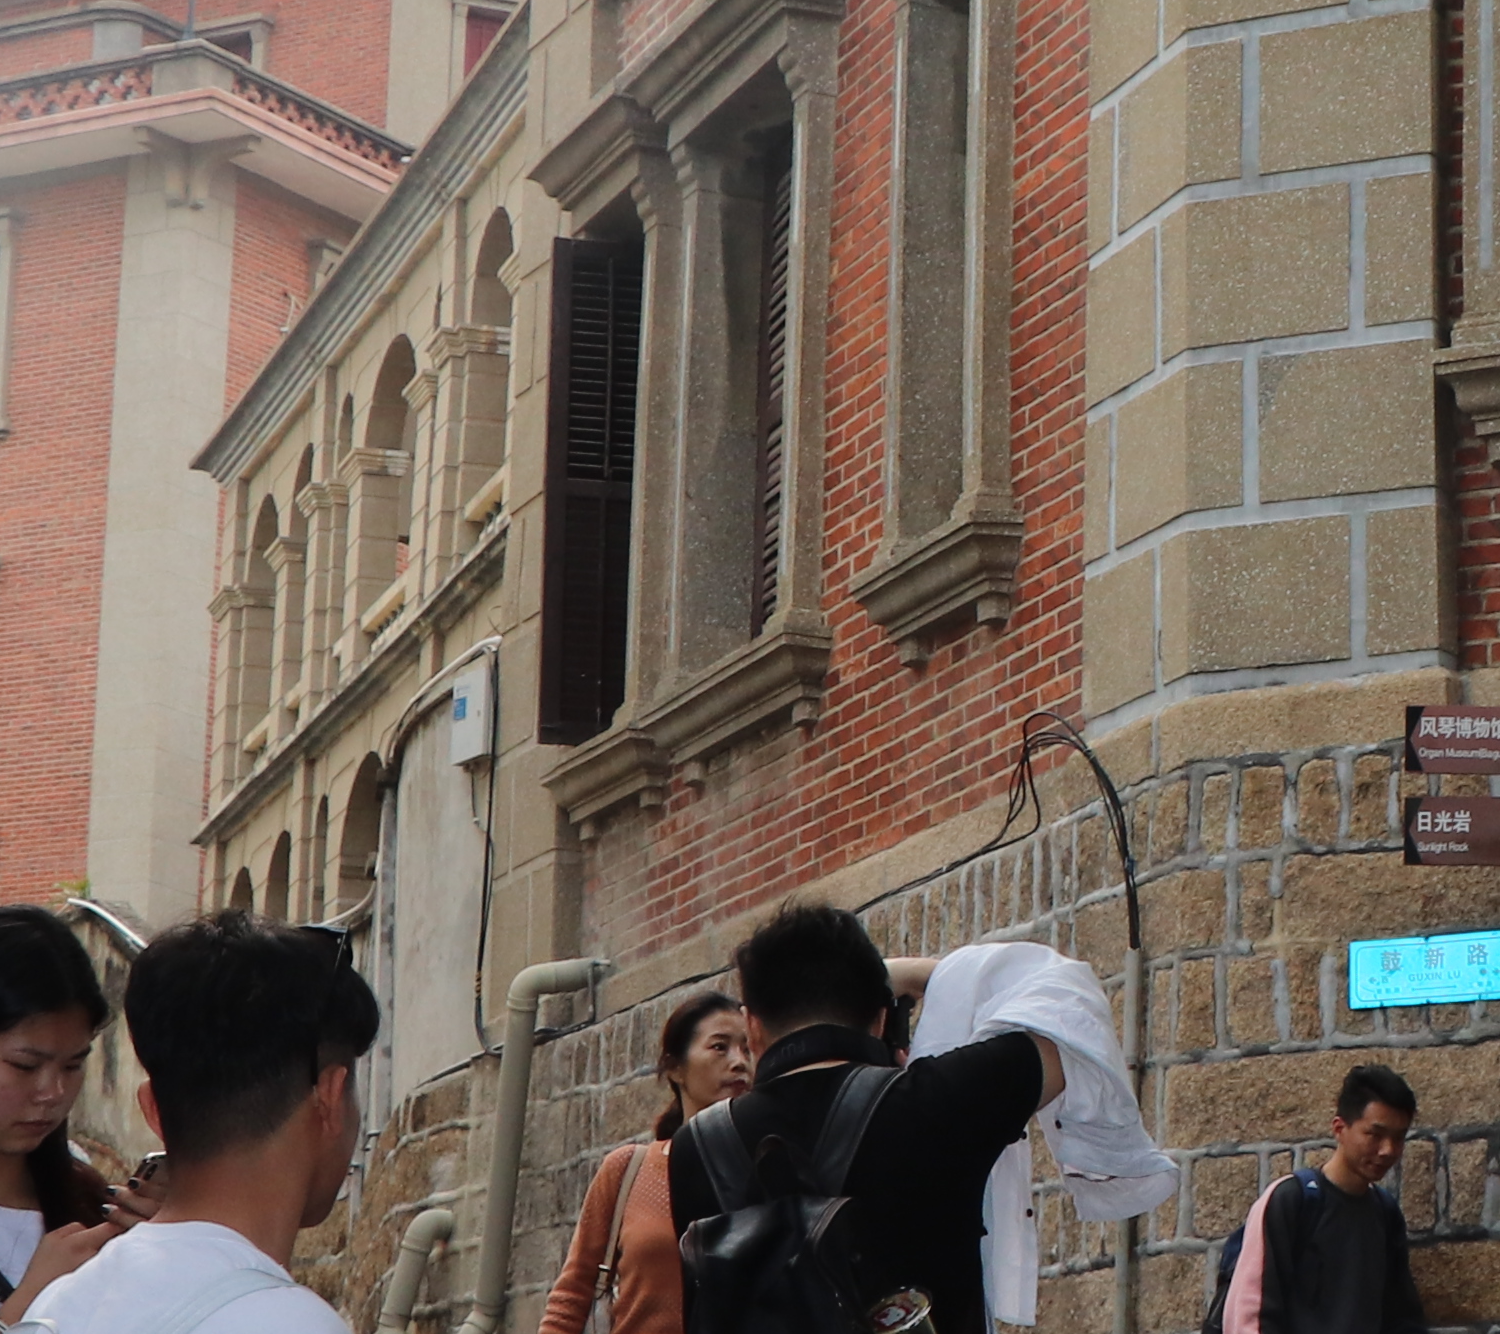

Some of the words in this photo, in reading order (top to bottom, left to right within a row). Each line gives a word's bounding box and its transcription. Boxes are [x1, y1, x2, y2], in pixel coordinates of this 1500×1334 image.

[1418, 747, 1445, 759] Organ
[1417, 810, 1472, 833] 日光岩
[1417, 841, 1447, 853] Sunlight
[1448, 842, 1469, 852] Rock
[1408, 971, 1443, 982] GUXIN
[1447, 970, 1461, 979] LU
